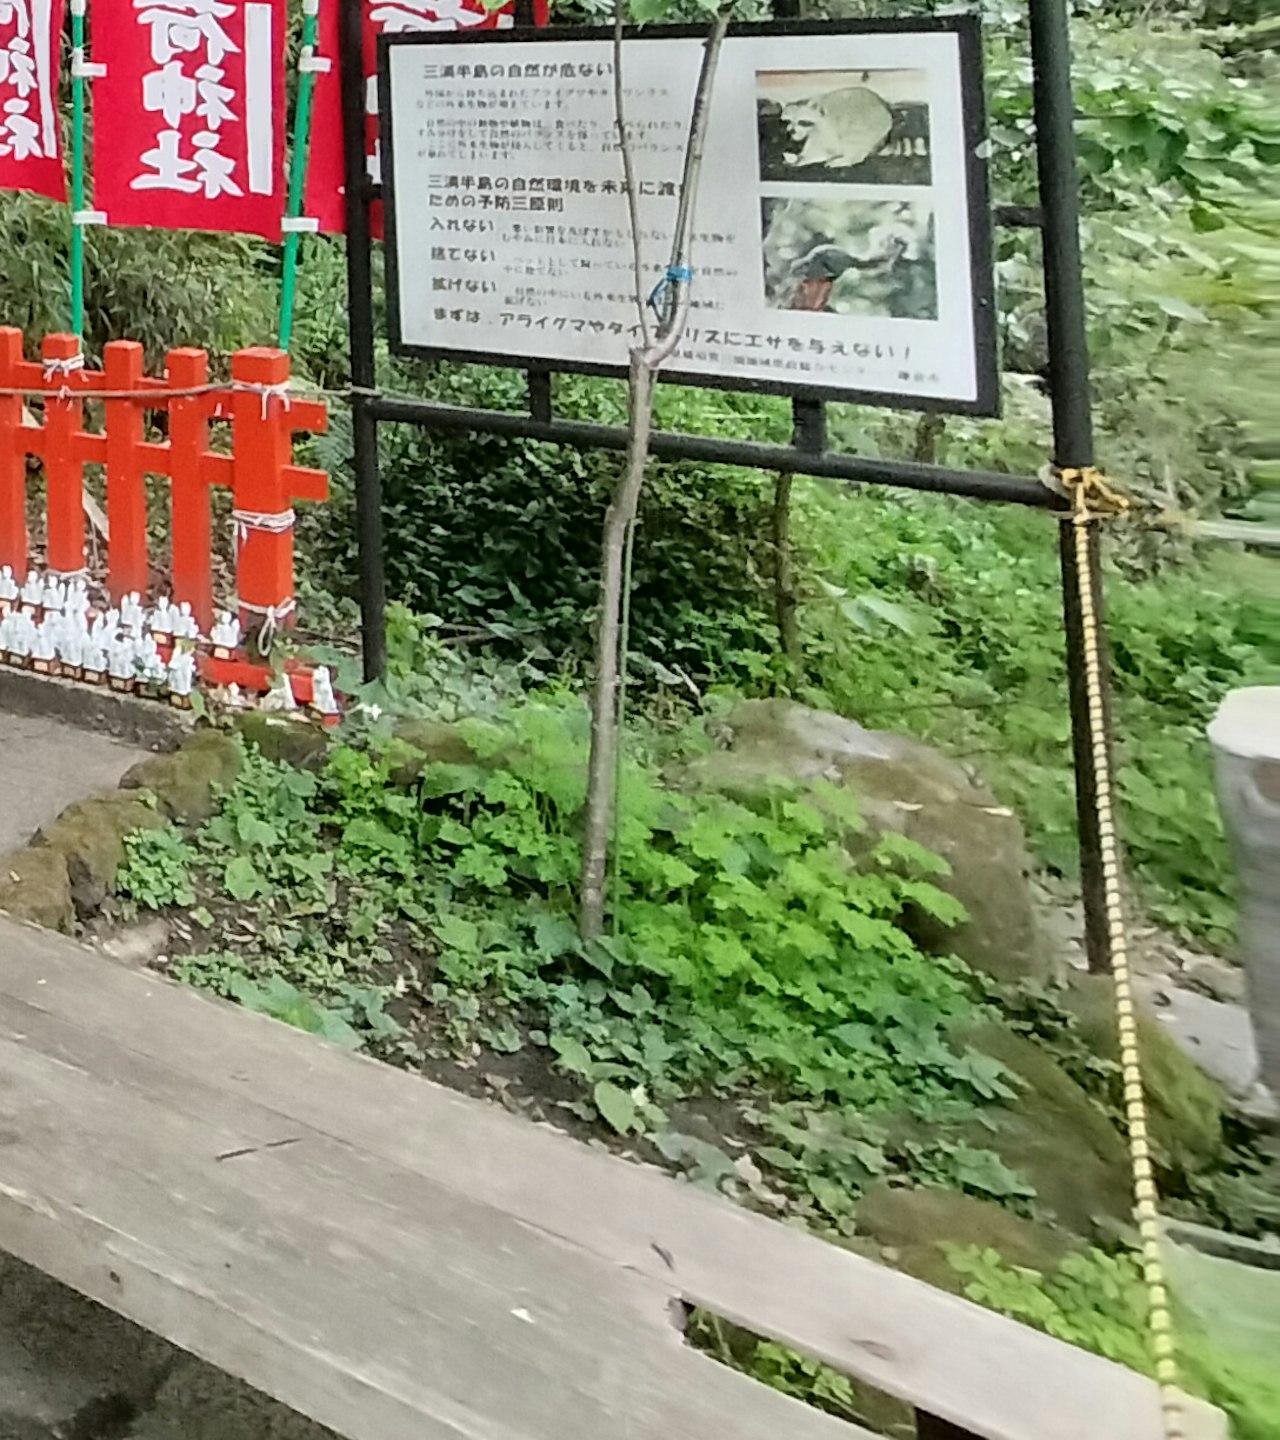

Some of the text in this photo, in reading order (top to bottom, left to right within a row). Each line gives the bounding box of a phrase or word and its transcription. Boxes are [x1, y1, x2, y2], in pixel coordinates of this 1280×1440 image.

[423, 62, 613, 79] 三浦半島の自然が危ない
[429, 194, 563, 213] ための予防三原則
[430, 217, 493, 232] 入れない
[431, 247, 496, 263] 捨てない
